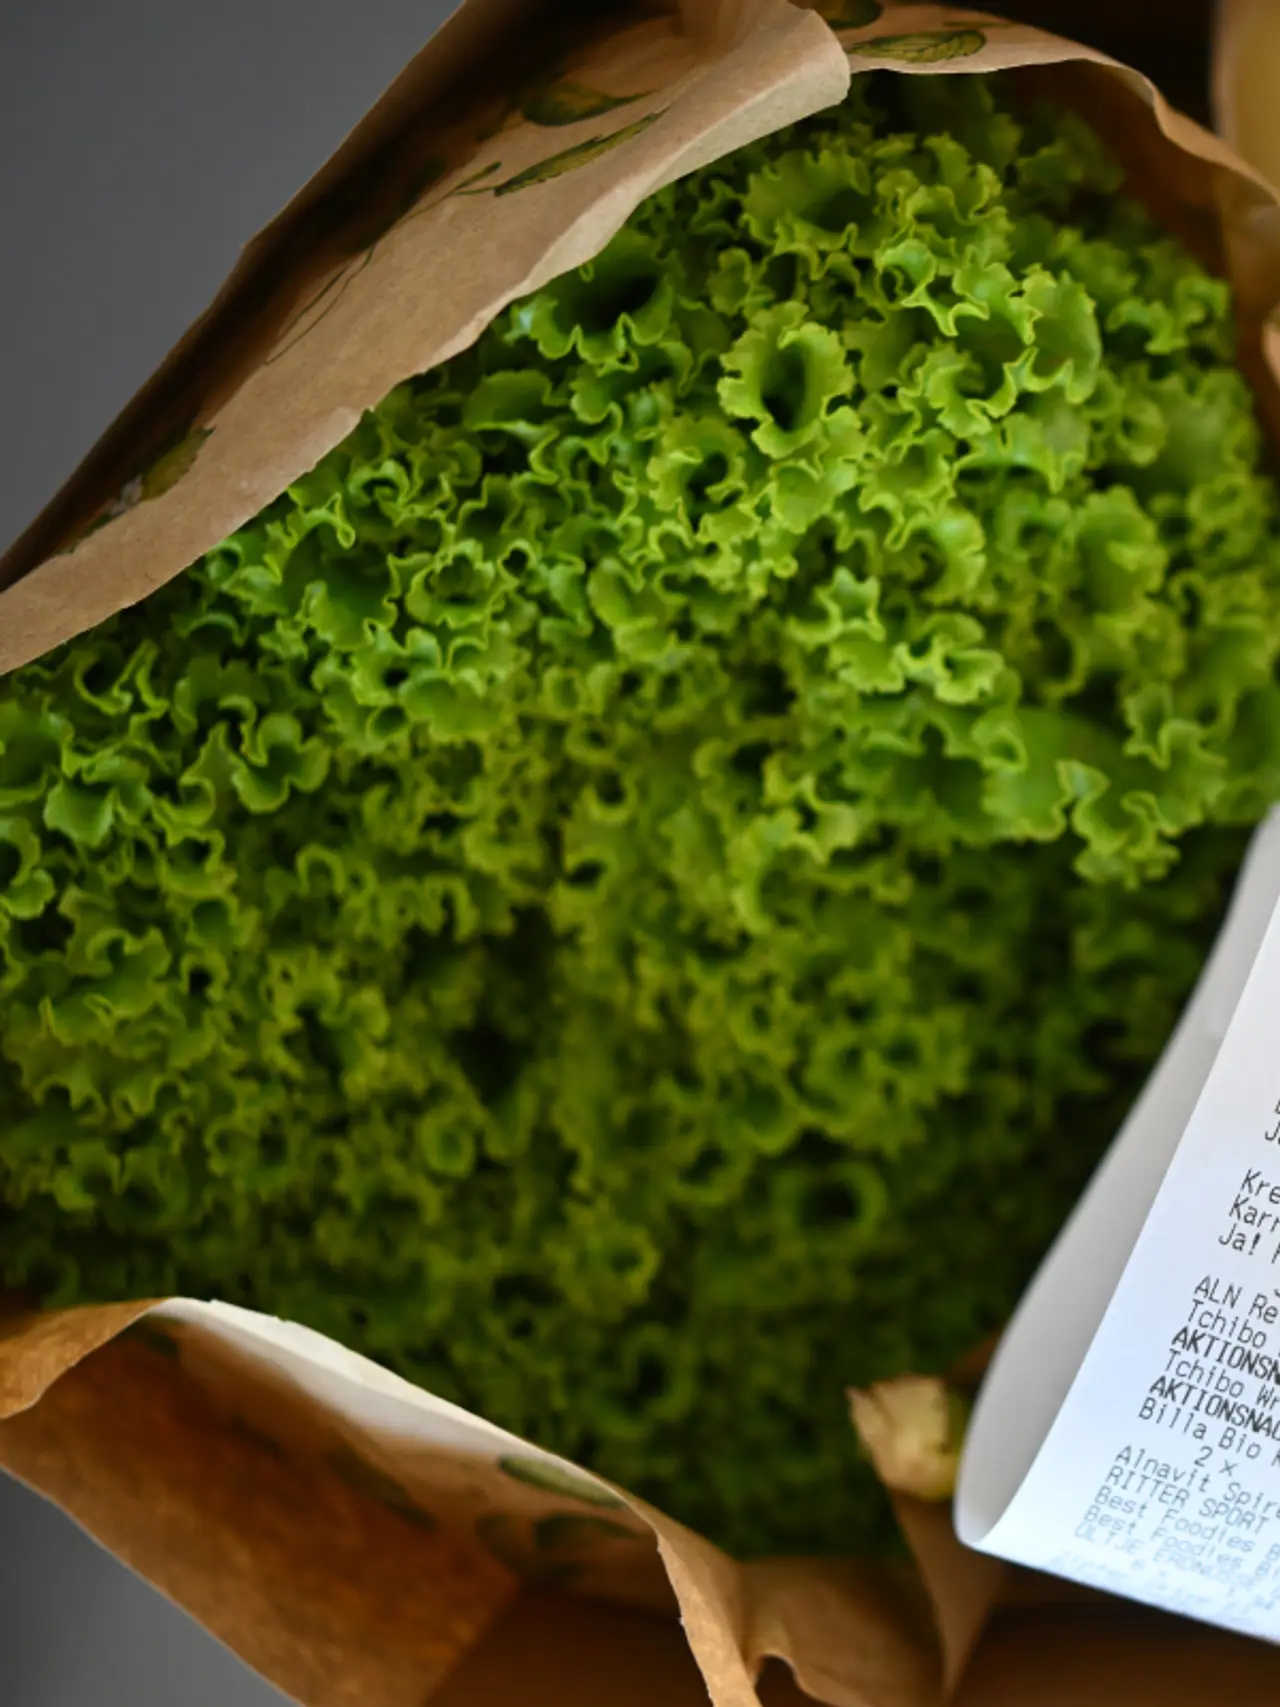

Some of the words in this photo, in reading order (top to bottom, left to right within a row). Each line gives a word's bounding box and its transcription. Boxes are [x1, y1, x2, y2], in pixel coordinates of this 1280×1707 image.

[1218, 1223, 1260, 1255] Ja!
[1194, 1276, 1242, 1308] ALN
[1188, 1300, 1266, 1348] Tchibo
[1165, 1349, 1244, 1397] Tchibo
[1138, 1397, 1206, 1439] Billa
[1218, 1428, 1261, 1459] Bio
[1115, 1445, 1209, 1492] Alnavit
[1193, 1445, 1213, 1467] 2
[1219, 1460, 1237, 1476] x
[1083, 1505, 1136, 1534] Best
[1094, 1486, 1147, 1518] Best
[1161, 1508, 1254, 1552] Foodies
[1105, 1465, 1189, 1507] RITTER
[1198, 1498, 1269, 1533] SPORT
